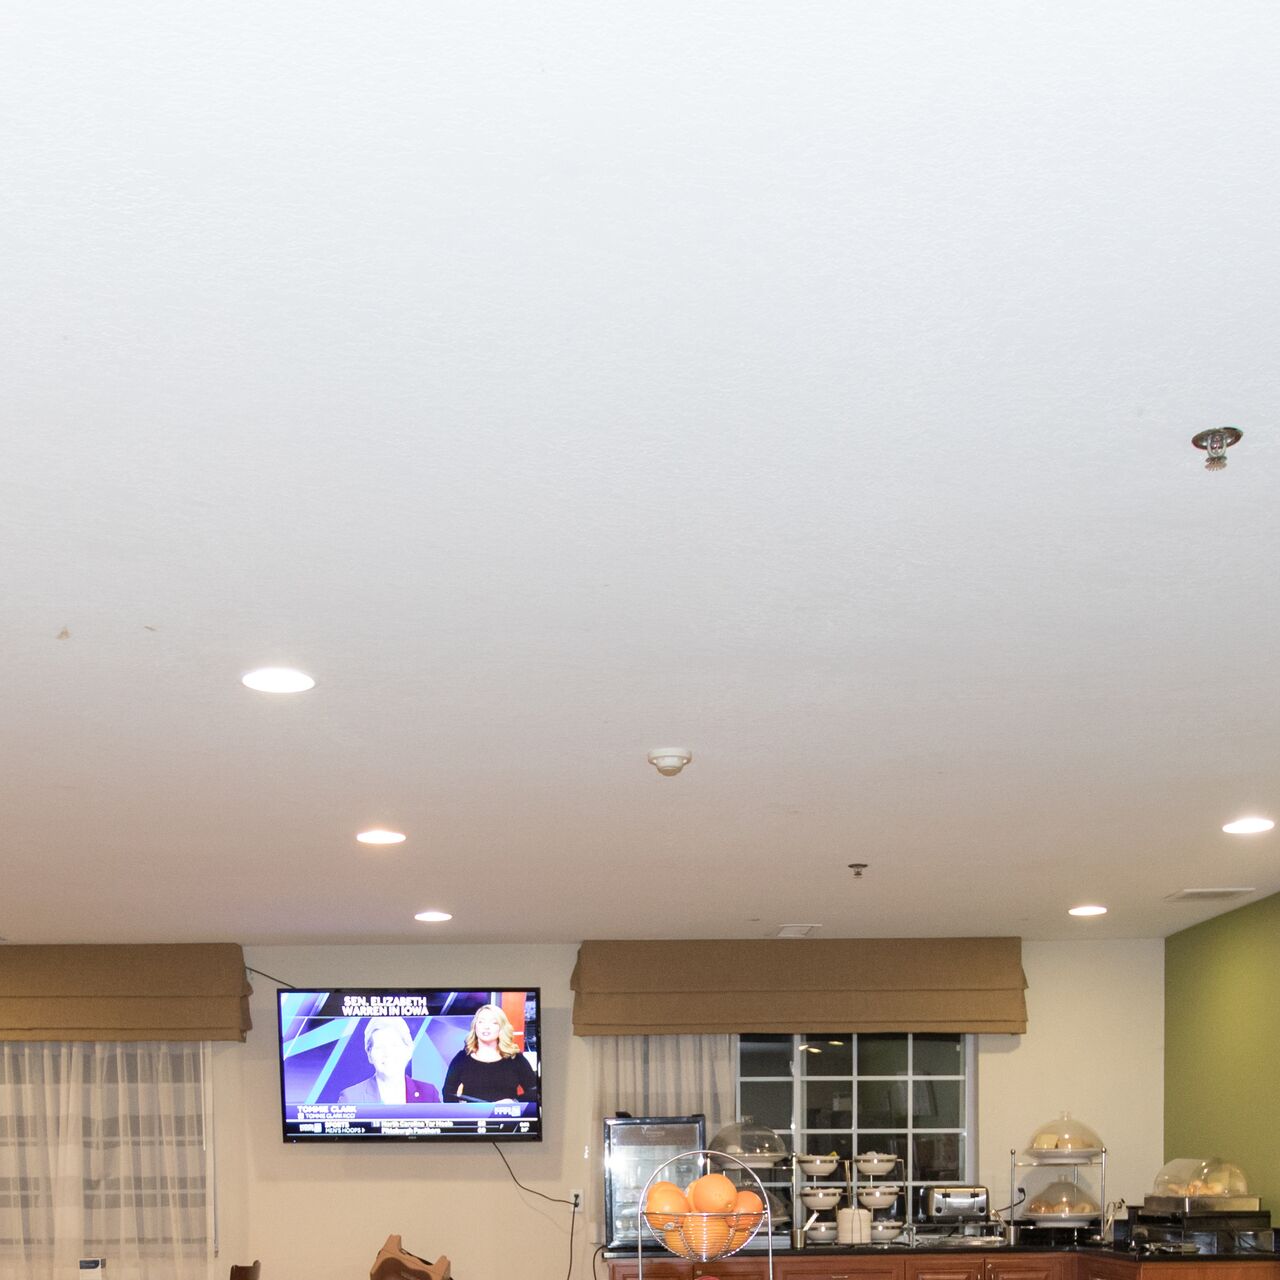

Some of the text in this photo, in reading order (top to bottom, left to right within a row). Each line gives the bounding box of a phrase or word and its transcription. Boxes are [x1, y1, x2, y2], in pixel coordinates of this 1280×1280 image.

[343, 996, 427, 1007] SEN. ELIZABETH
[342, 1006, 429, 1016] WARREN IN IOWA
[400, 1120, 425, 1128] Carolina
